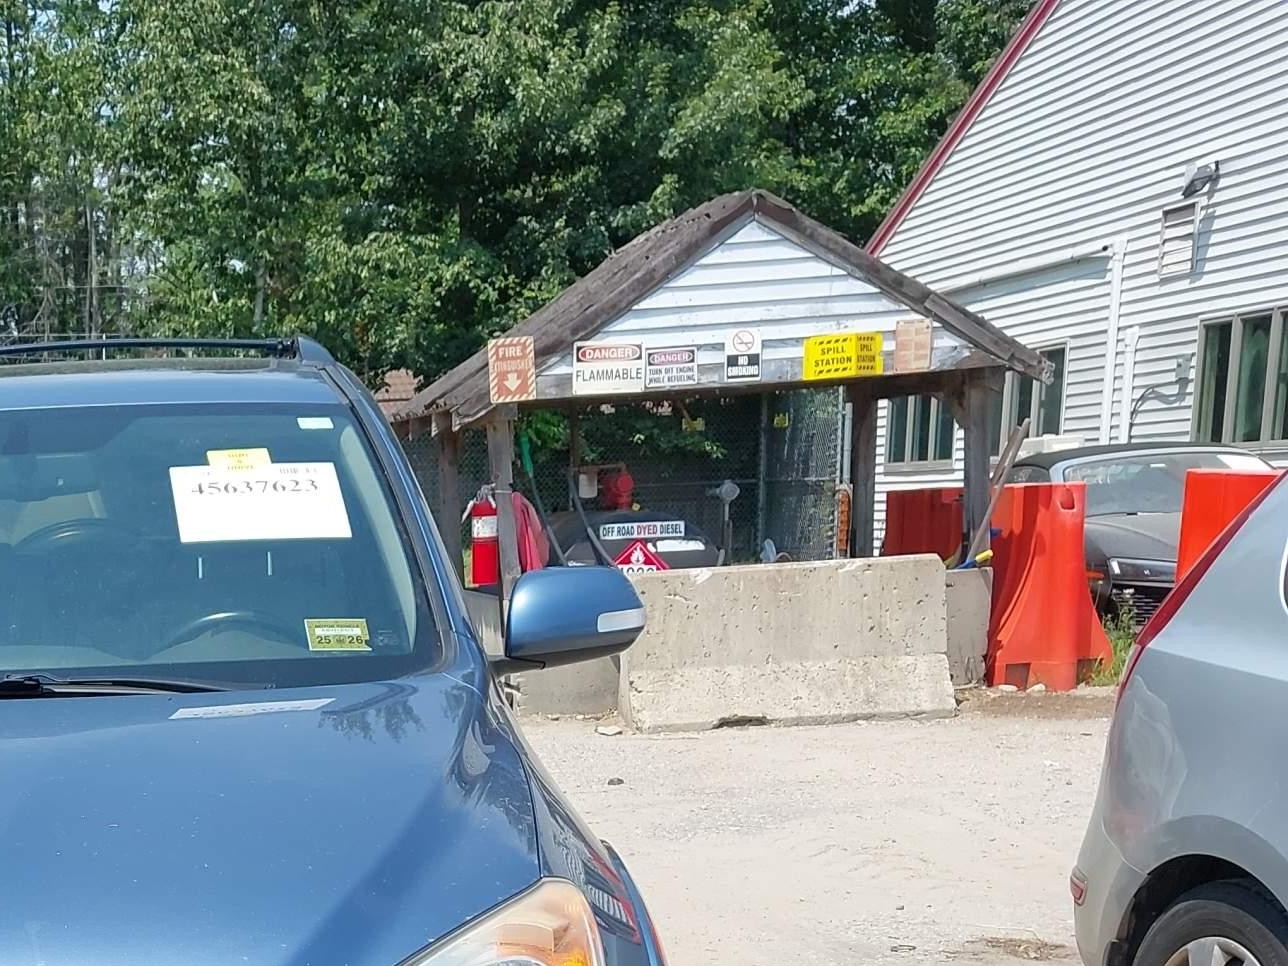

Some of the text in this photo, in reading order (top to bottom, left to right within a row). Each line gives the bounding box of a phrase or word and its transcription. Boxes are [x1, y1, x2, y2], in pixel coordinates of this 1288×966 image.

[498, 345, 523, 358] FIRE
[585, 347, 633, 359] DANGER
[820, 345, 846, 356] SPILL
[860, 343, 872, 352] SPILL
[654, 352, 689, 363] DANGER
[738, 355, 749, 365] NO
[814, 356, 852, 368] STATION
[857, 354, 876, 363] STATION
[575, 367, 642, 382] FLAMMABLE
[648, 365, 695, 376] TURN OFF ENGINE
[727, 365, 759, 377] SMOKING
[667, 374, 696, 383] REFUELING
[191, 479, 319, 495] 45637623
[602, 523, 683, 537] OFF ROAD DYED DIESEL
[316, 635, 364, 645] 25 26
